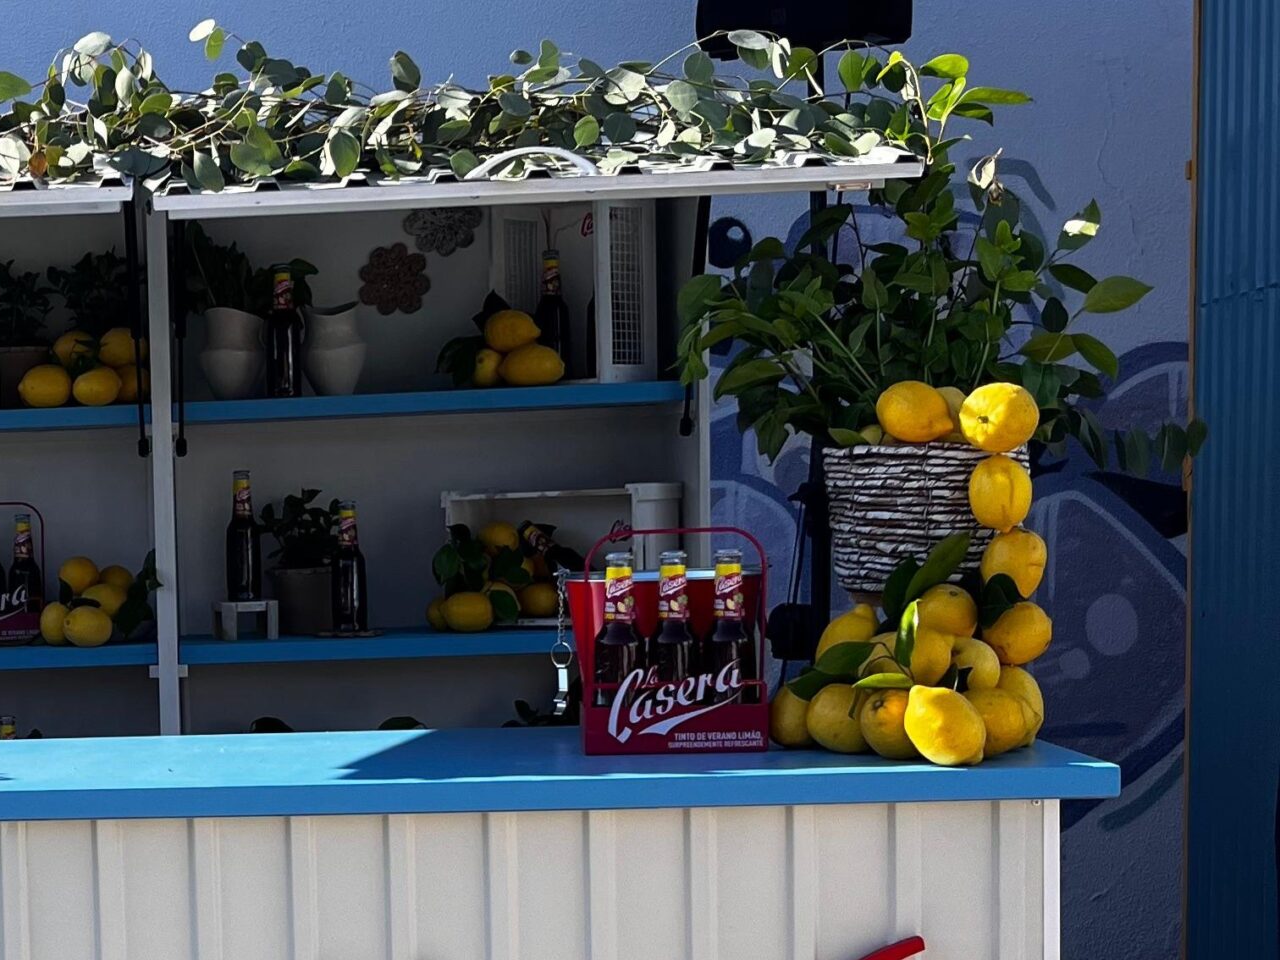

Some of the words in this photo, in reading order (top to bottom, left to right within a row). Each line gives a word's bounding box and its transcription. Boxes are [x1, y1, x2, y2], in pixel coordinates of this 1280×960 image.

[642, 665, 659, 689] La
[607, 658, 746, 744] Casera
[675, 733, 696, 741] TINTO
[697, 732, 707, 741] DE
[707, 731, 737, 740] VERANO
